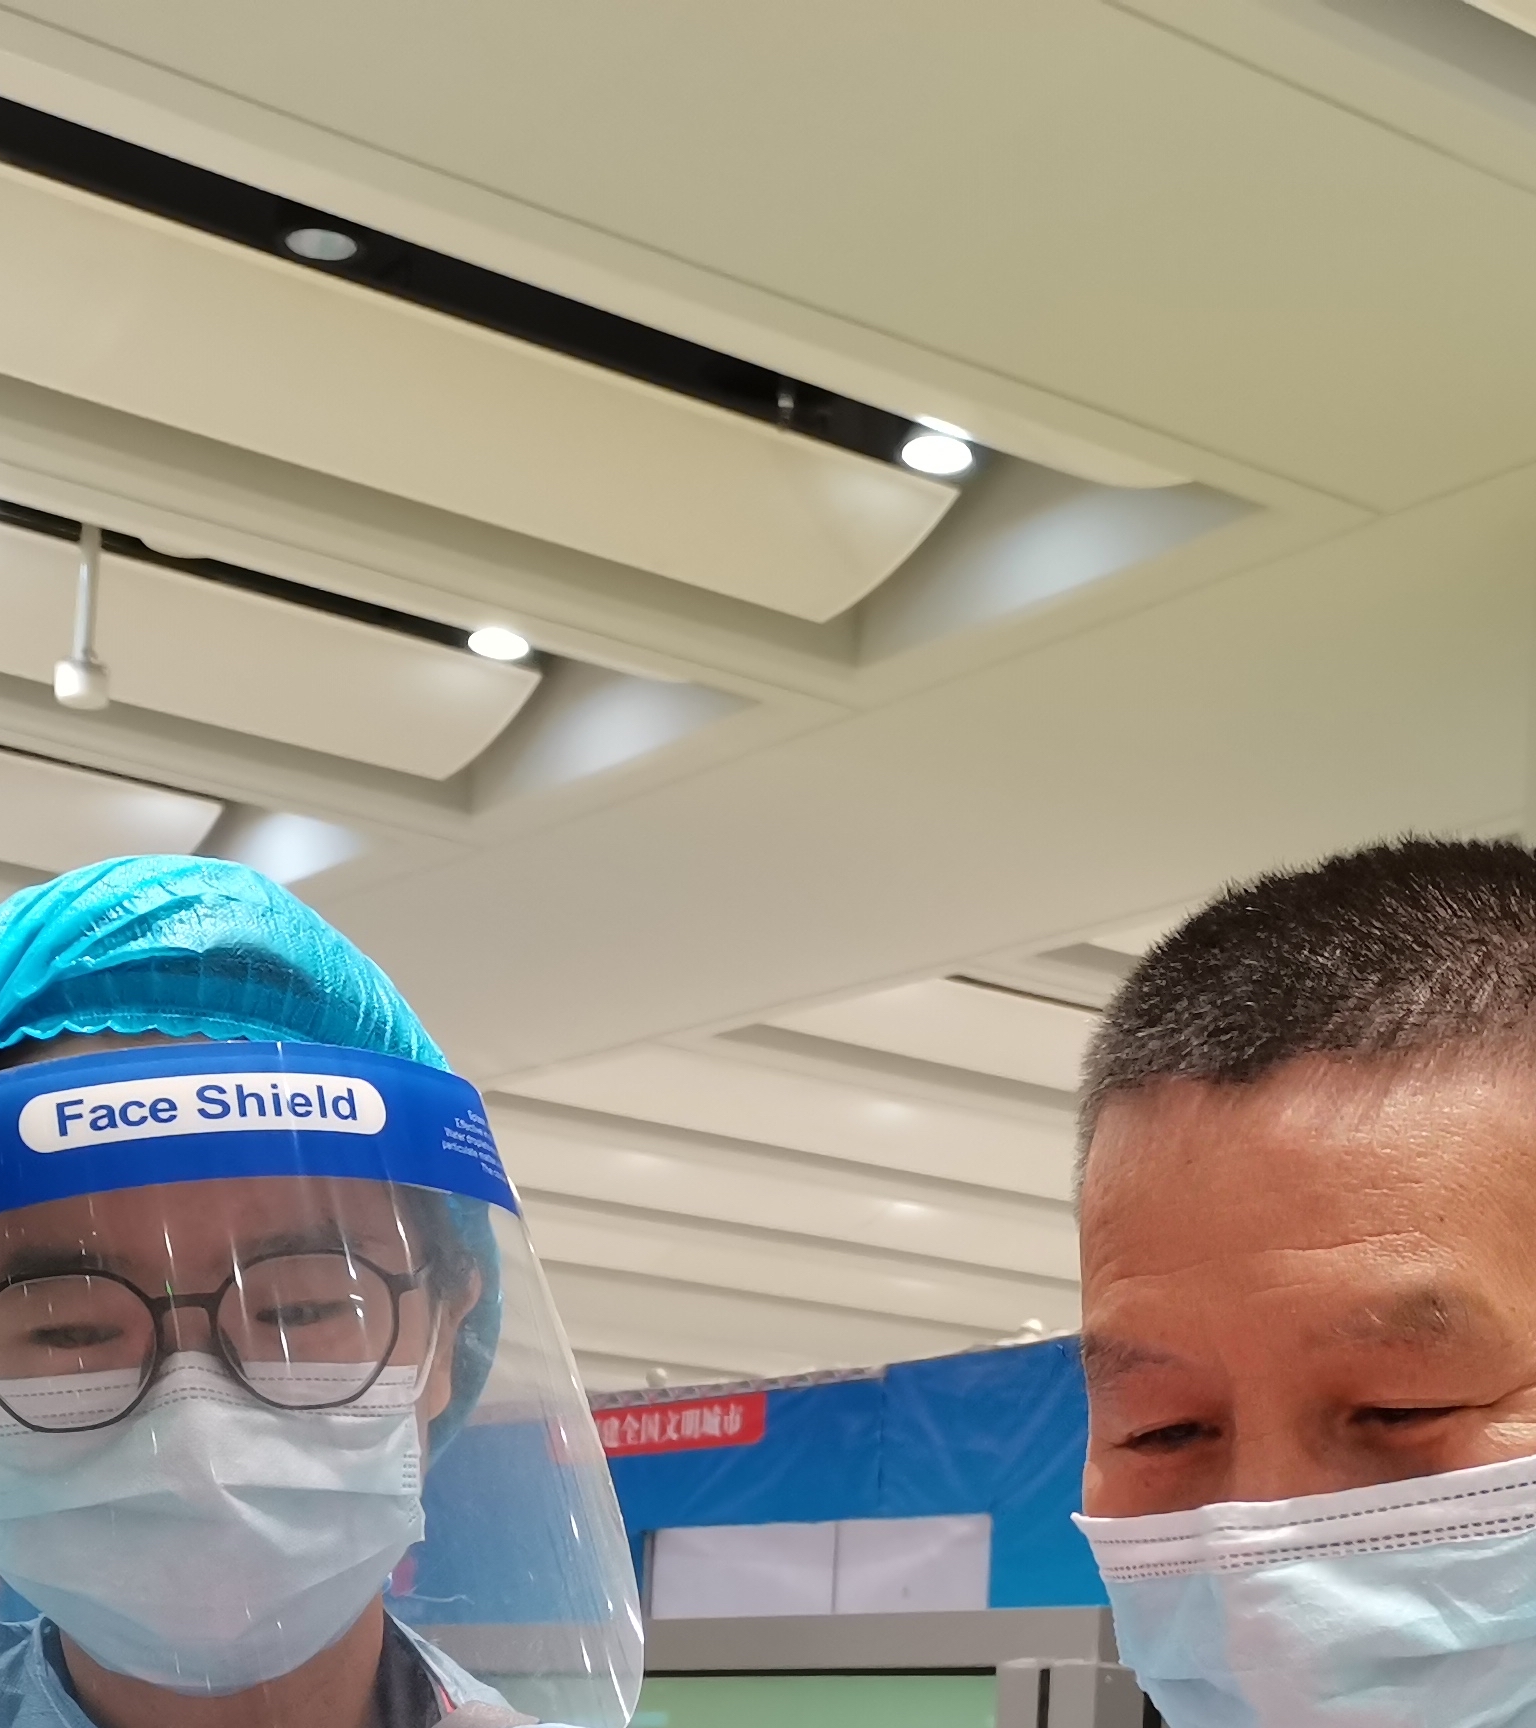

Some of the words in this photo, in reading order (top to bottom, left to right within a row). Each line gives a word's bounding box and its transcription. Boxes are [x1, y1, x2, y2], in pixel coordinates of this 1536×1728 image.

[56, 1097, 178, 1138] Face
[196, 1082, 358, 1122] Shield
[595, 1402, 743, 1449] 建全国文明城市
